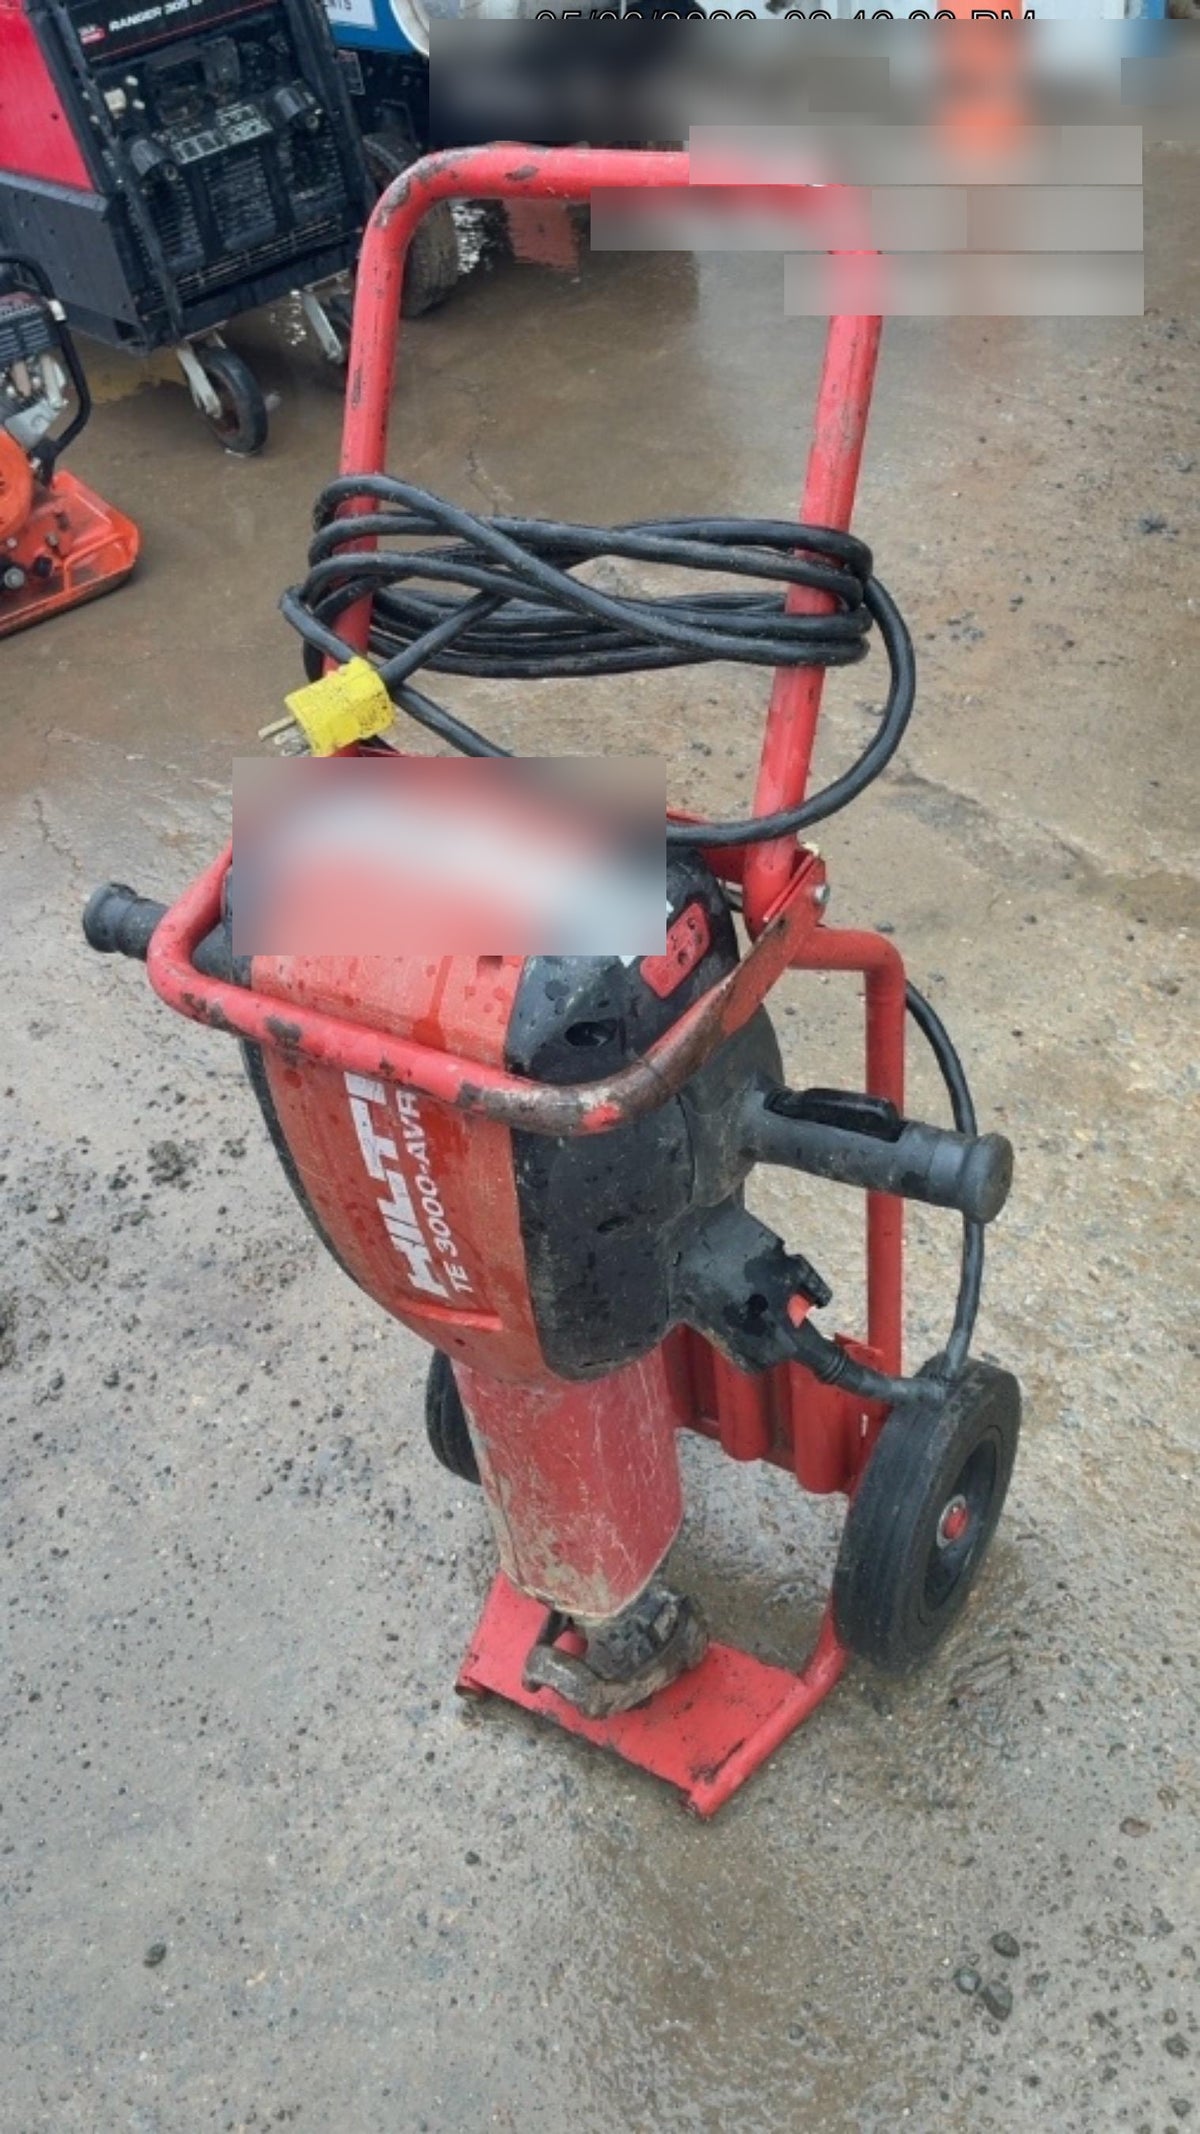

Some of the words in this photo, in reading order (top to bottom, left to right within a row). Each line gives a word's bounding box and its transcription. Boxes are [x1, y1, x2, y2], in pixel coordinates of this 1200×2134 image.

[108, 6, 162, 32] RANGER
[343, 1071, 449, 1297] HILTI
[443, 1261, 473, 1293] TE
